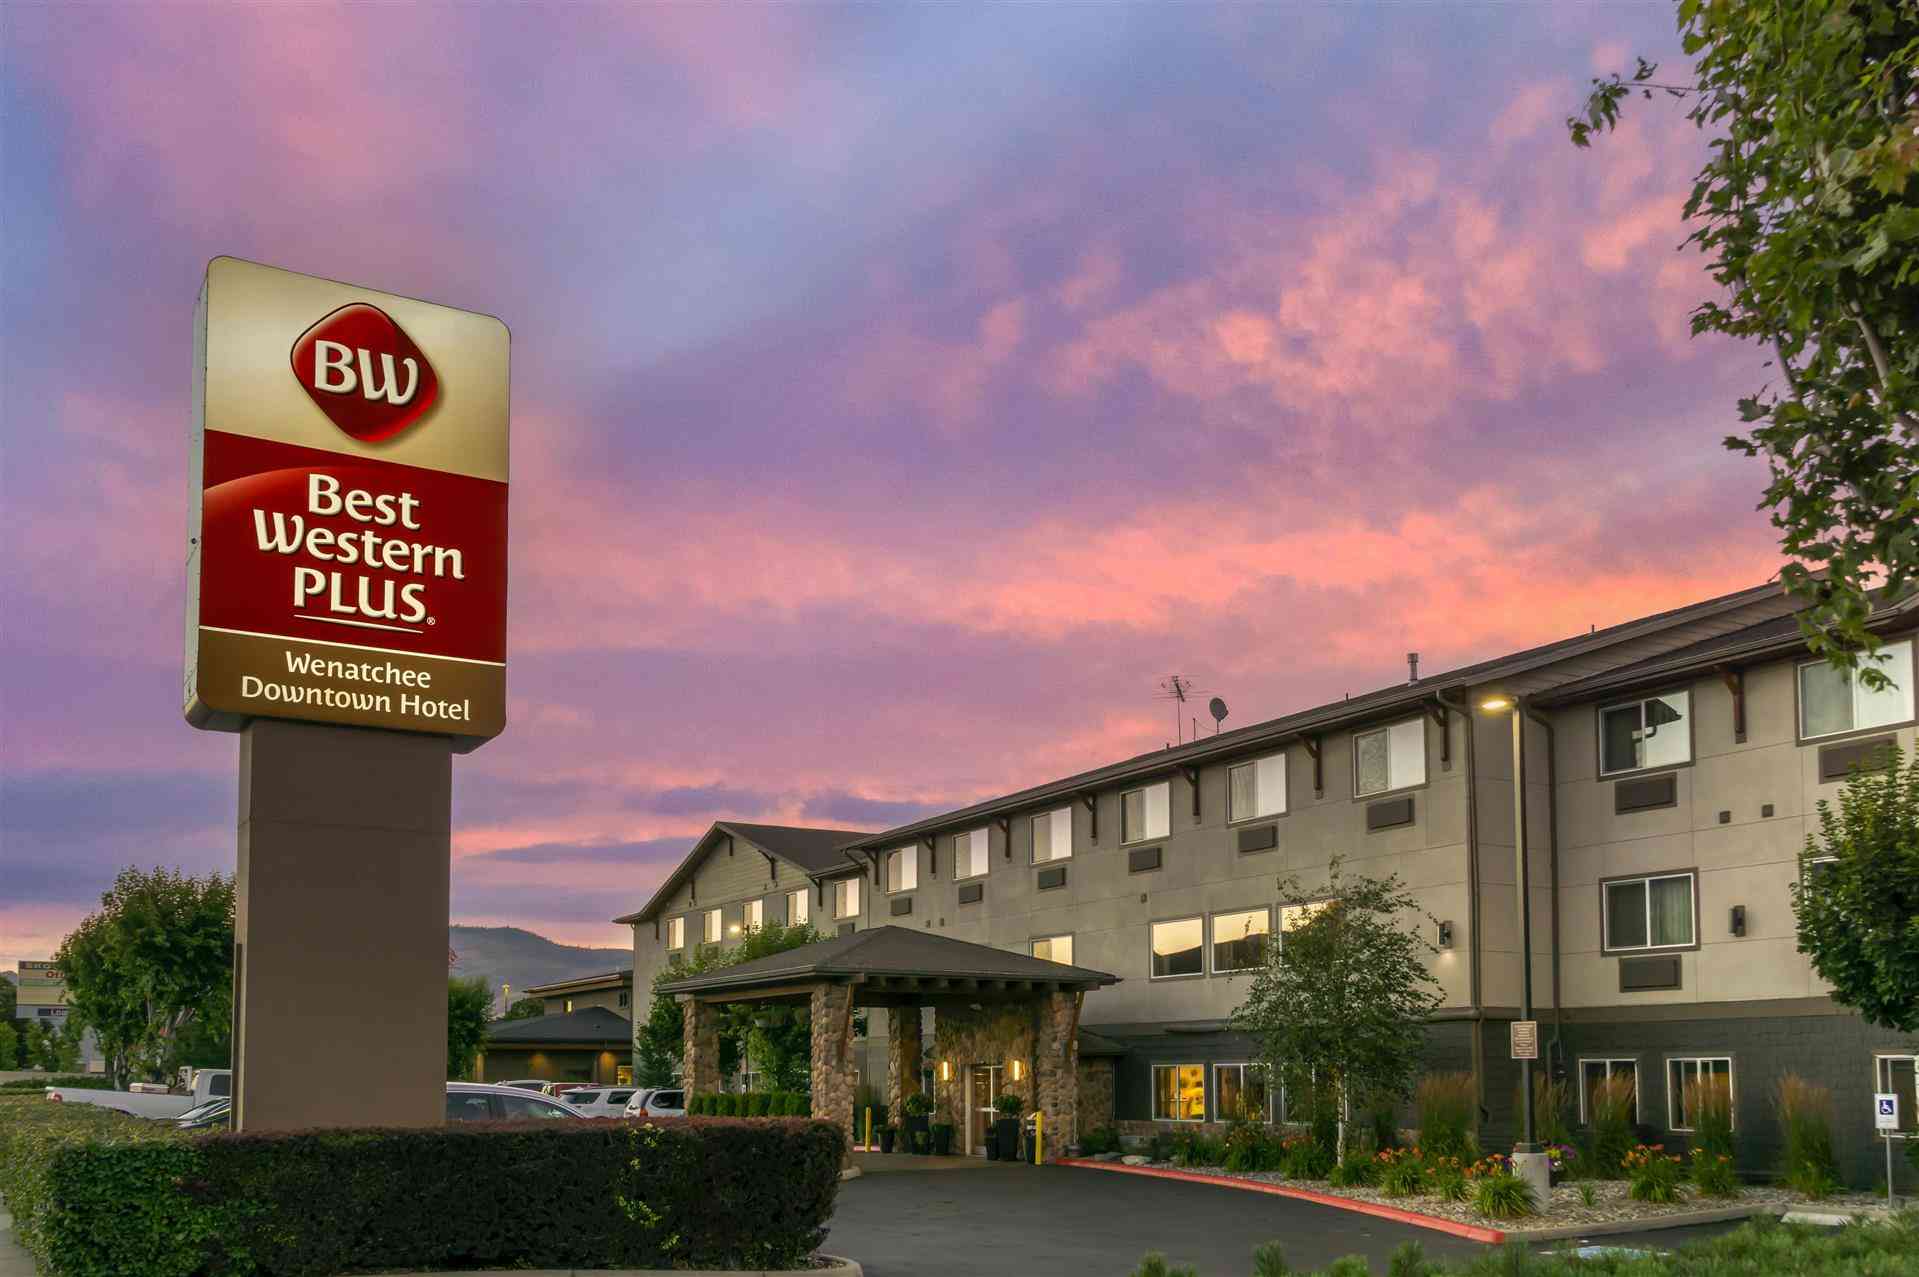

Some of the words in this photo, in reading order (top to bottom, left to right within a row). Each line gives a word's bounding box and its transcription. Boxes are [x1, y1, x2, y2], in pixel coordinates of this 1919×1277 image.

[314, 339, 419, 405] BW
[307, 472, 420, 530] Best
[252, 508, 464, 580] Western
[241, 676, 393, 713] Downtown
[399, 694, 472, 721] Hotel
[285, 651, 432, 688] Wenatchee
